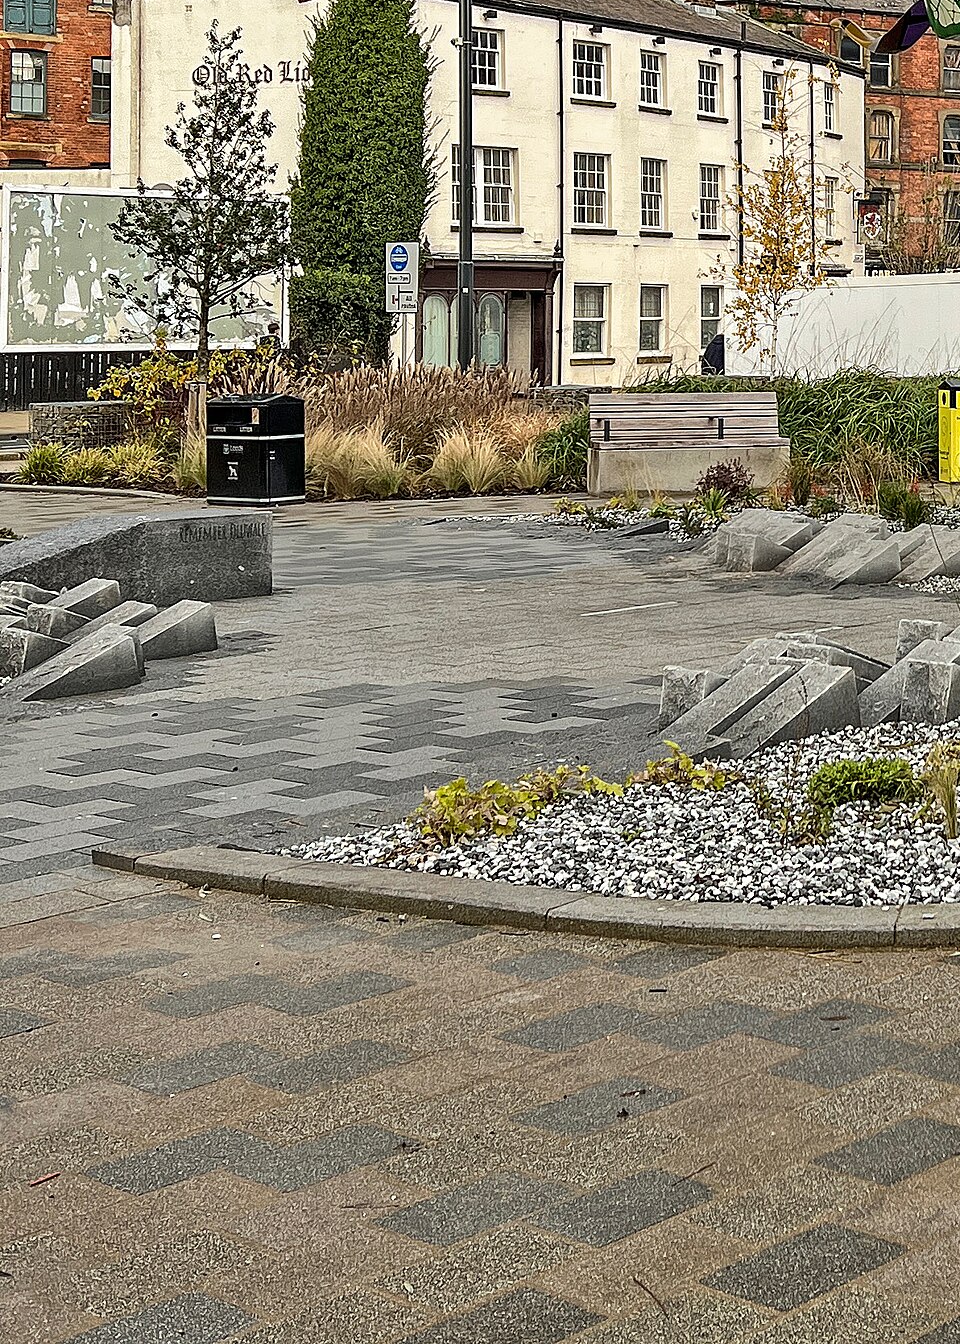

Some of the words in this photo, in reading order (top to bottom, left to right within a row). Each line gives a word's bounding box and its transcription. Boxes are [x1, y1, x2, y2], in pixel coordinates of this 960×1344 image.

[192, 64, 228, 86] Old
[236, 62, 273, 84] Red
[278, 60, 310, 84] Lio
